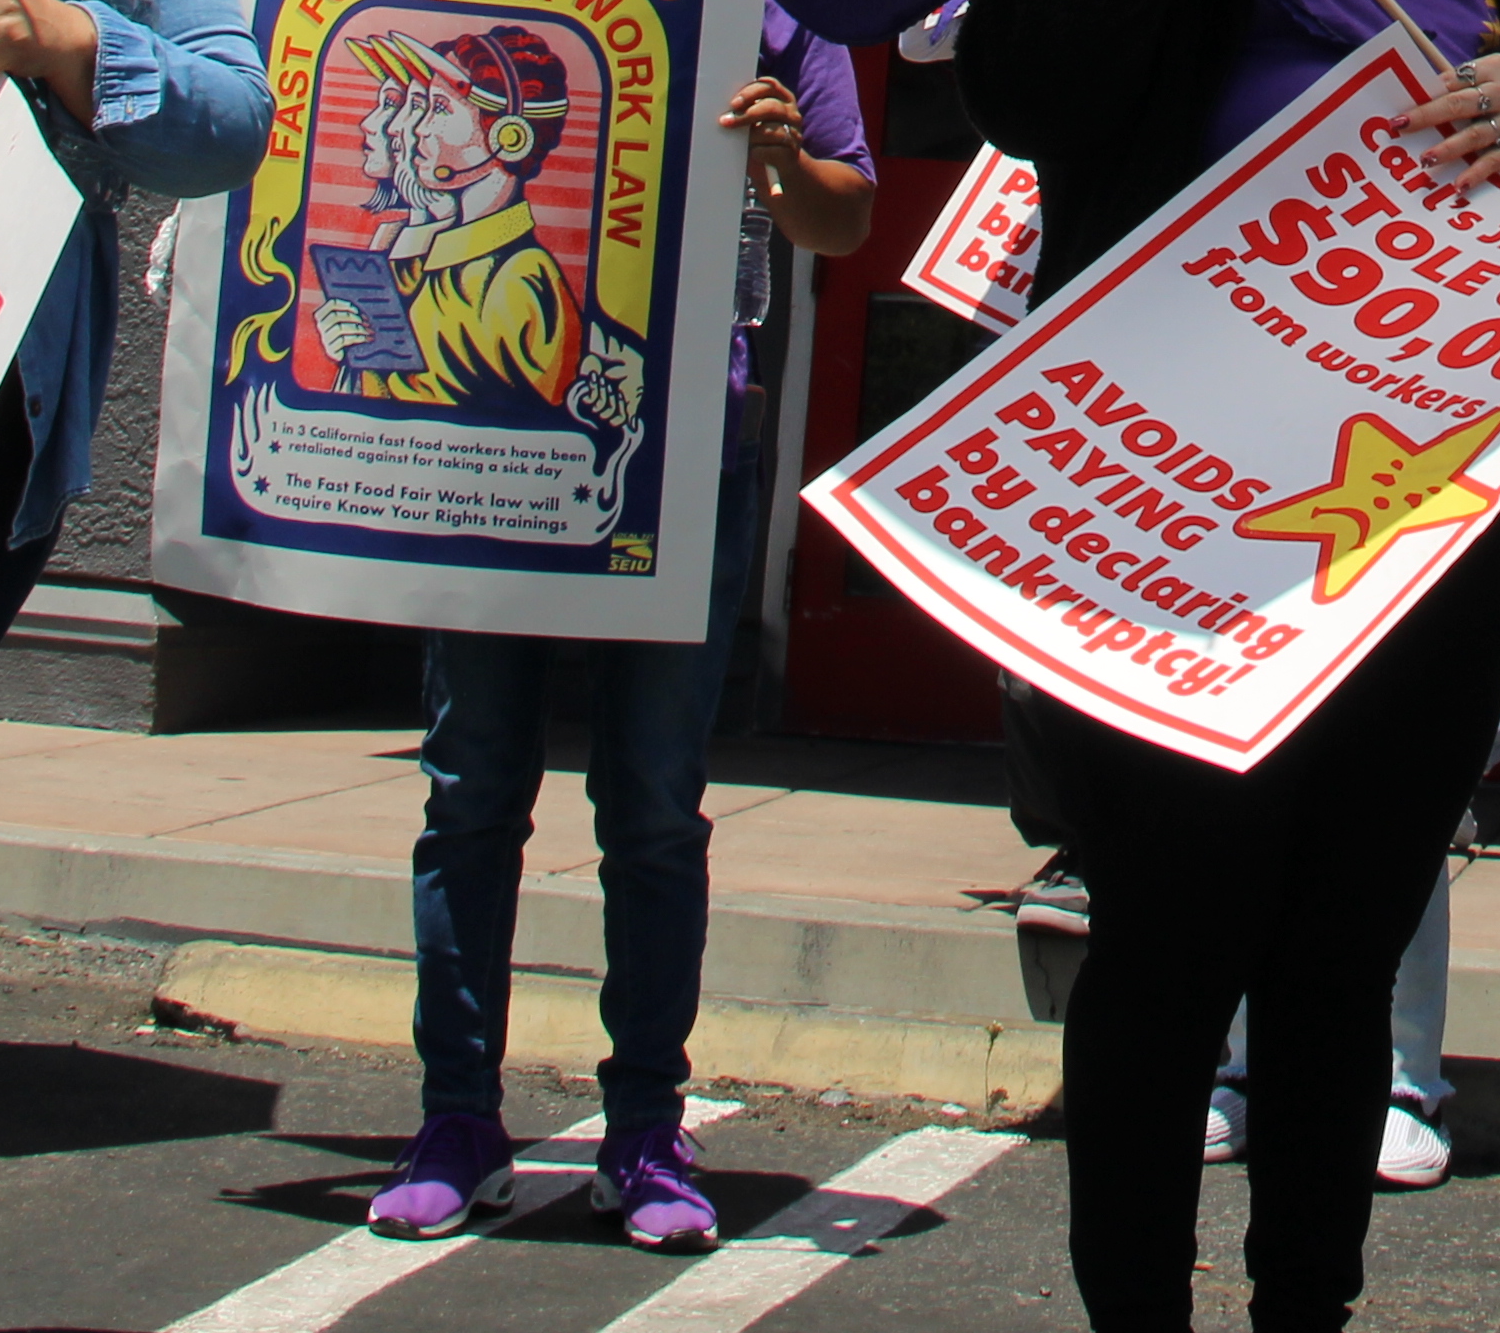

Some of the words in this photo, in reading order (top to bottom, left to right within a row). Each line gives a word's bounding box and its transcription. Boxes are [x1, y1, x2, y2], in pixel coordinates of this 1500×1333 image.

[269, 35, 316, 160] FAST
[606, 137, 652, 250] LAW
[977, 202, 1042, 256] by
[1182, 246, 1304, 347] from
[1307, 340, 1488, 421] workers
[271, 421, 277, 433] 1
[282, 422, 294, 435] in
[297, 425, 306, 436] 3
[310, 427, 374, 445] California
[379, 433, 404, 448] fast
[409, 437, 442, 451] food
[447, 441, 506, 458] workers
[511, 445, 546, 461] have
[551, 448, 587, 463] been
[288, 441, 353, 459] retaliated
[357, 448, 408, 465] against
[413, 452, 434, 467] for
[438, 456, 484, 474] taking
[489, 463, 497, 473] a
[502, 461, 529, 476] sick
[534, 462, 563, 481] day
[995, 391, 1220, 553] PAYING
[1041, 360, 1271, 517] AVOIDS
[275, 494, 332, 512] require
[337, 499, 384, 517] Know
[391, 505, 429, 522] Your
[435, 508, 487, 528] Rights
[492, 514, 568, 535] trainings
[286, 473, 312, 490] The
[317, 477, 350, 493] Fast
[354, 481, 394, 499] Food
[400, 486, 433, 502] Fair
[437, 489, 484, 507] Work
[490, 492, 523, 510] law
[529, 497, 560, 512] will
[946, 427, 1040, 510] by
[1029, 495, 1305, 660] declaring
[608, 559, 652, 572] SEIU
[895, 467, 1257, 700] bankruptcy!
